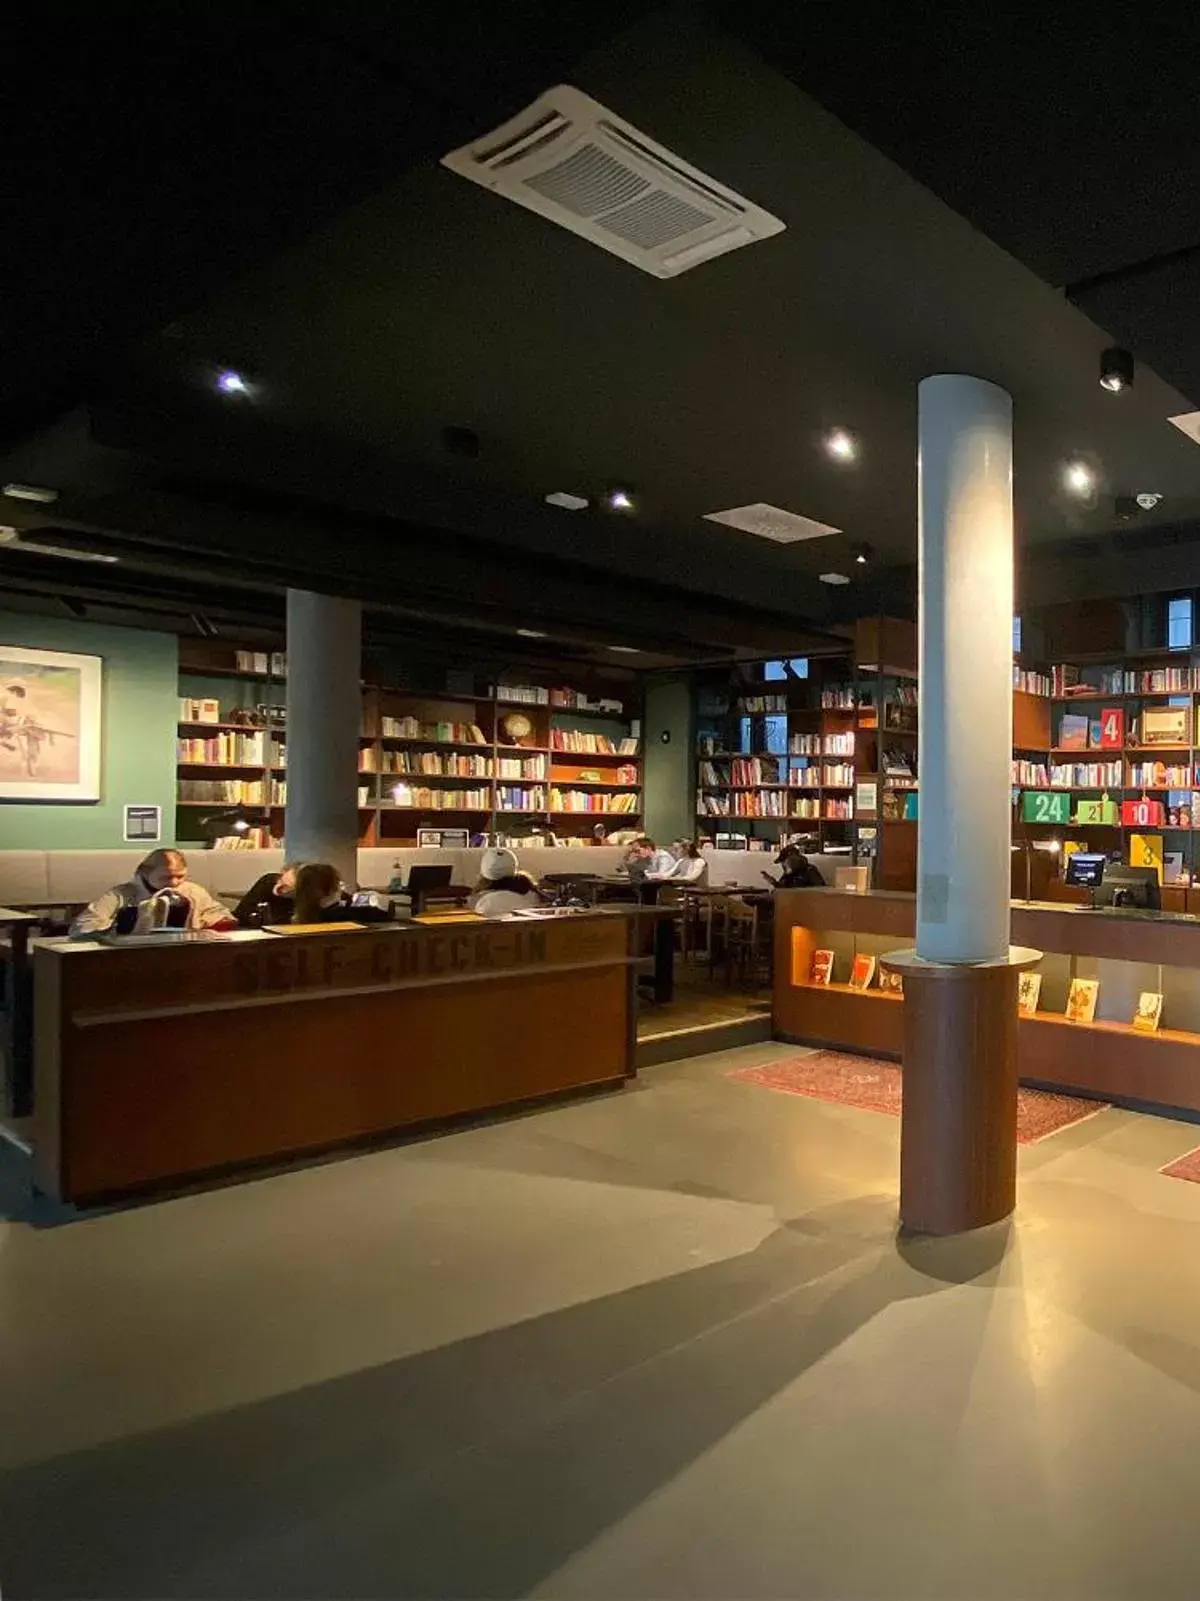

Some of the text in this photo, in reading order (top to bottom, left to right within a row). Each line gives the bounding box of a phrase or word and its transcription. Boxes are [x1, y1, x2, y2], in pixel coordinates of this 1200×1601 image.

[1104, 714, 1119, 742] 4
[1035, 794, 1063, 822] 24
[1088, 803, 1104, 822] 21
[1131, 803, 1149, 826] 10
[370, 929, 548, 982] CHECK-IN
